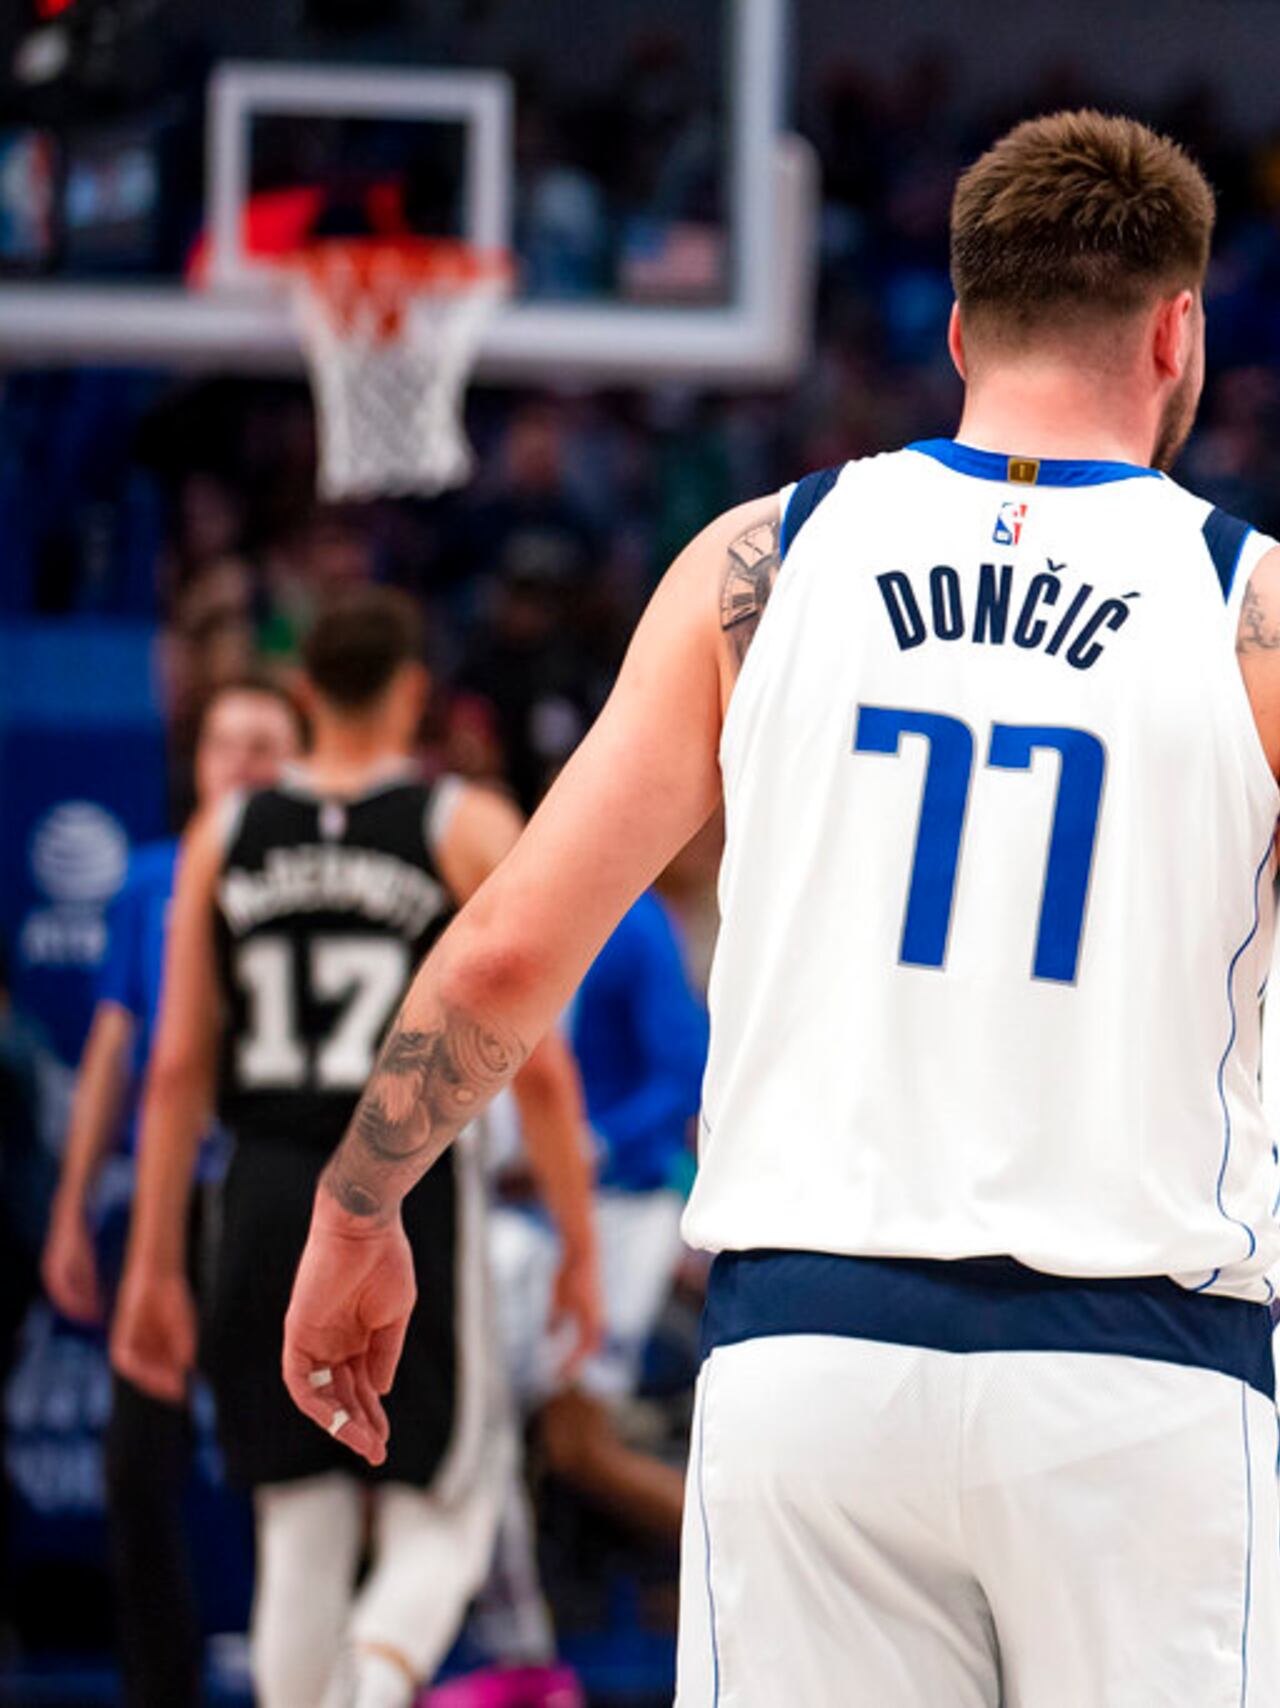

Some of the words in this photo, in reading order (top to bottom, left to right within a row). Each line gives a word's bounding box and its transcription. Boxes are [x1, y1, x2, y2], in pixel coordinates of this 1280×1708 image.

[876, 559, 1140, 671] DONČIĆ
[852, 702, 1109, 988] 77
[236, 936, 407, 1087] 17
